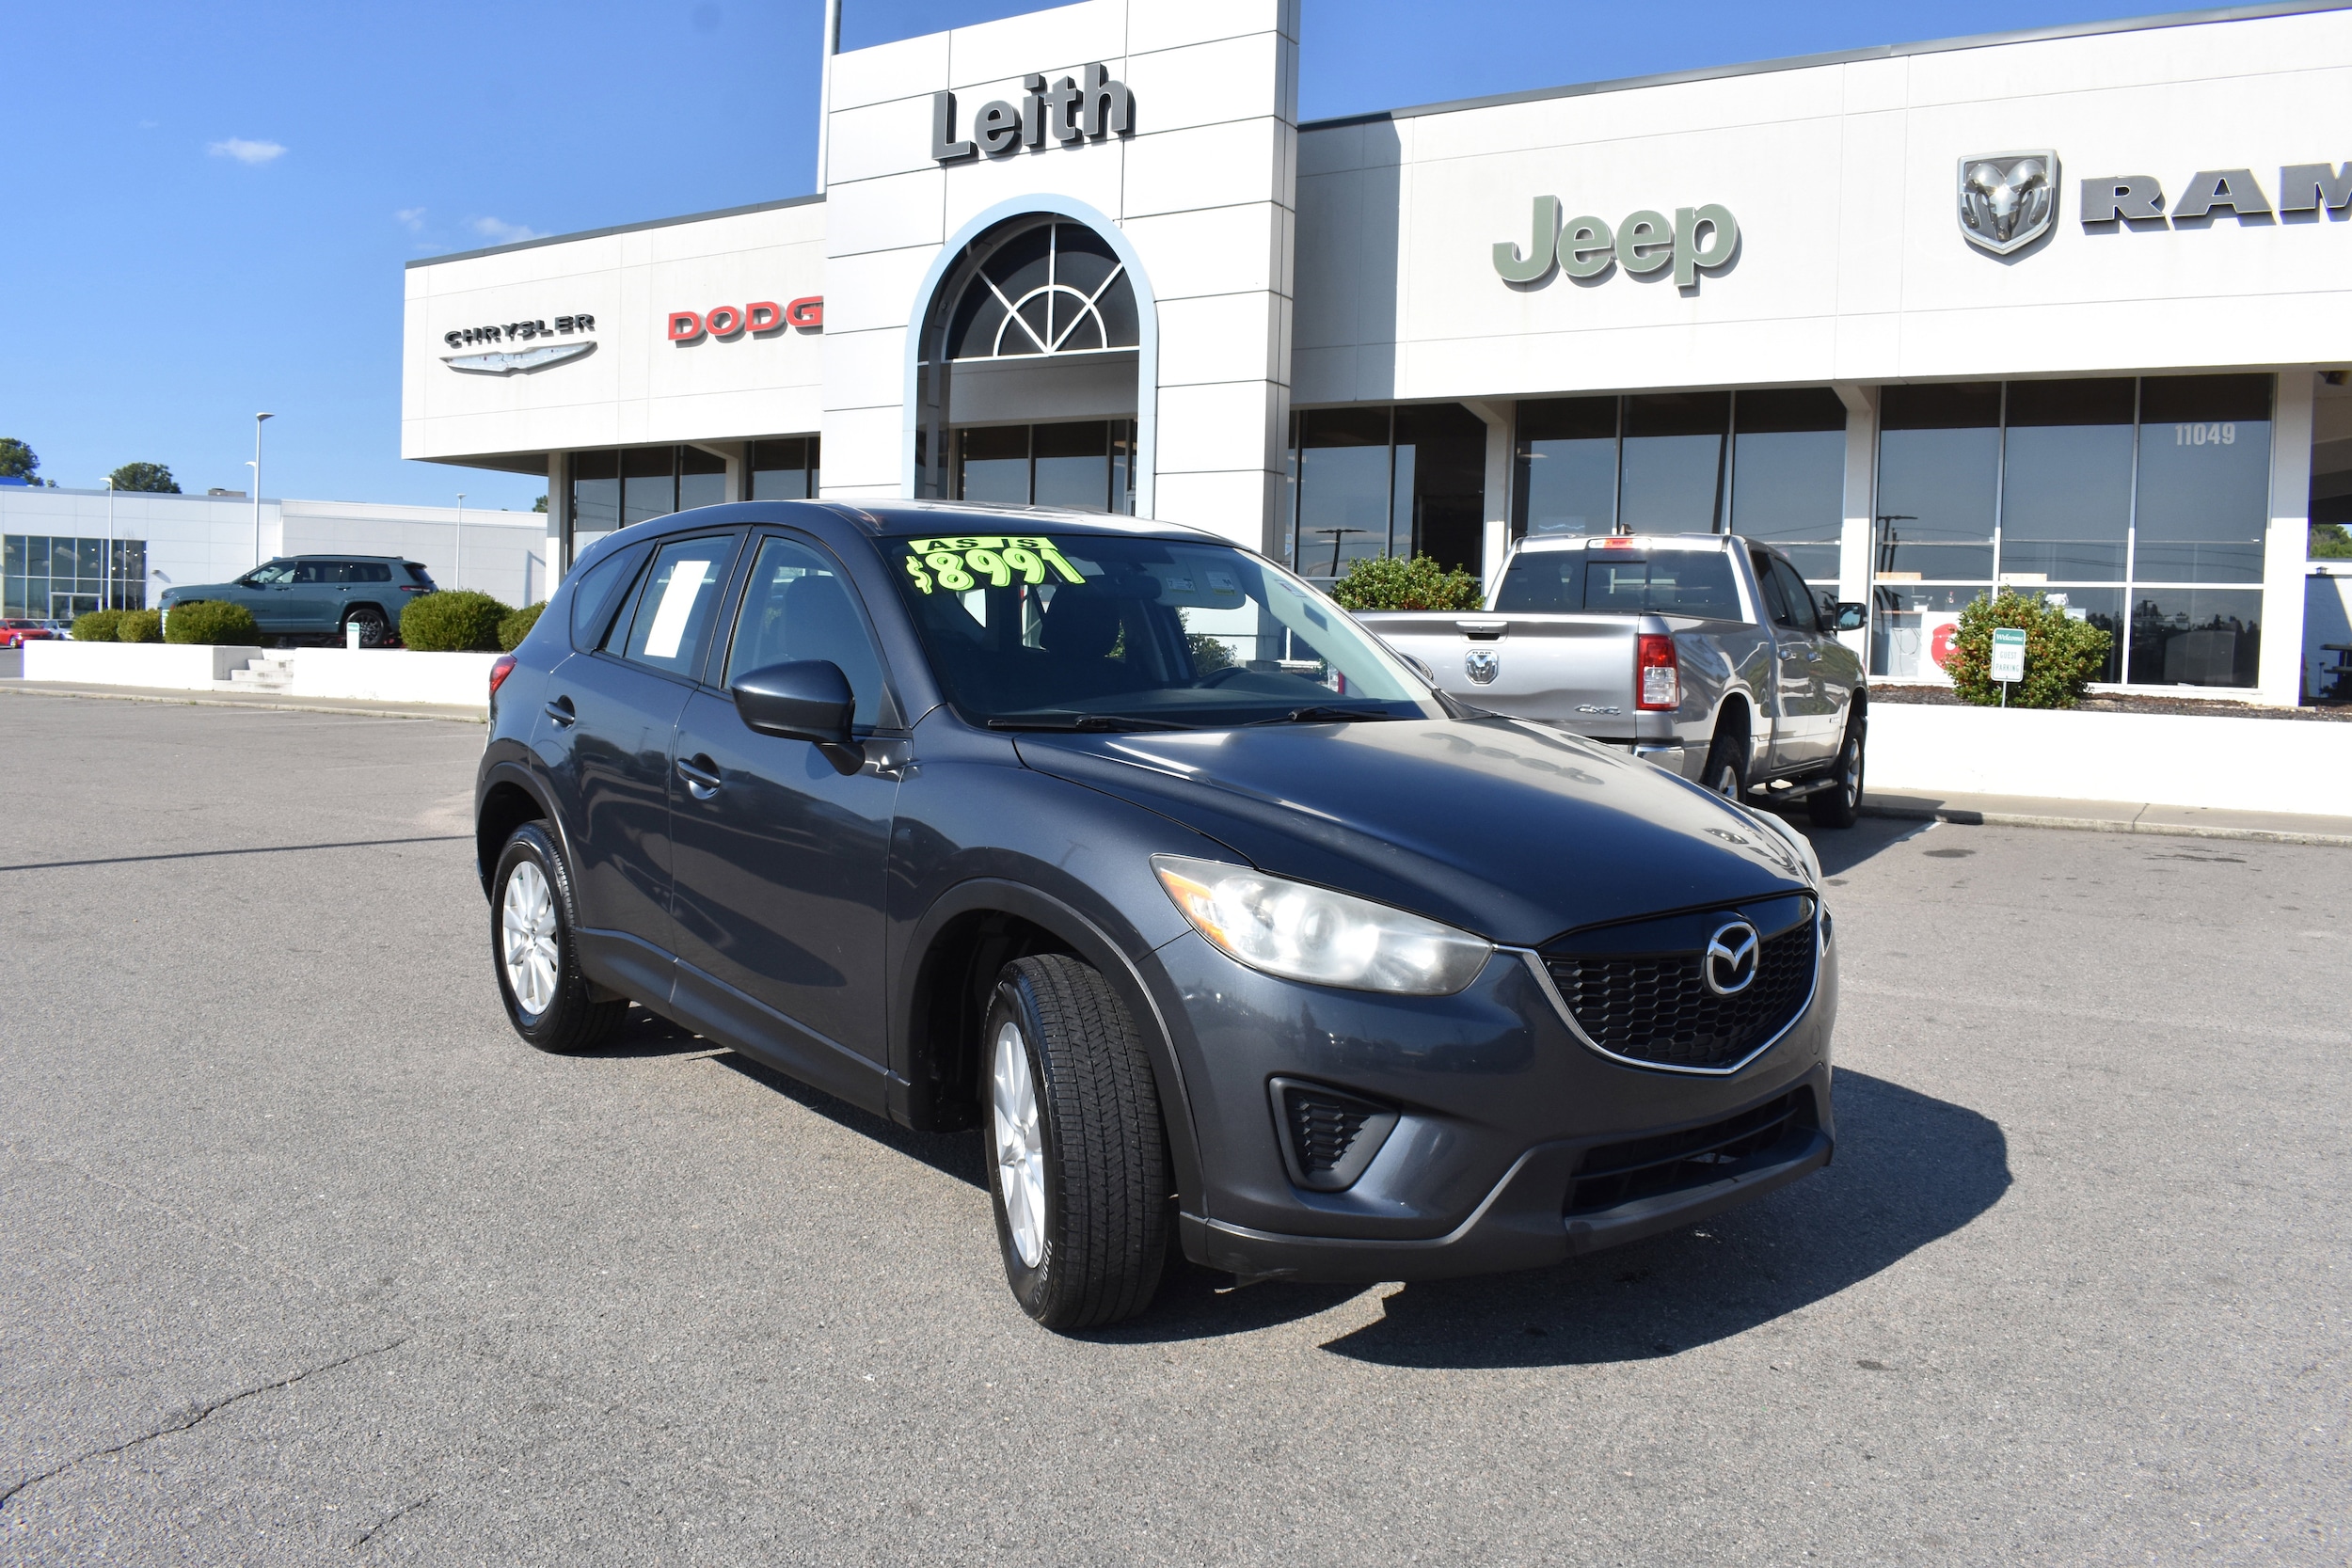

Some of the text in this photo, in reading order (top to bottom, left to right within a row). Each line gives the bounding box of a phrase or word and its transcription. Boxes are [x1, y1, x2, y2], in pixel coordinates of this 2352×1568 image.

[931, 62, 1134, 162] Leith
[2080, 161, 2352, 223] RAM
[1492, 194, 1740, 287] Jeep
[444, 313, 596, 347] CHRYSLER
[2175, 422, 2235, 445] 11049
[927, 537, 1041, 551] AS IS
[1995, 633, 2024, 641] Welcome
[1999, 651, 2017, 659] GUEST
[1995, 663, 2020, 672] PARKING
